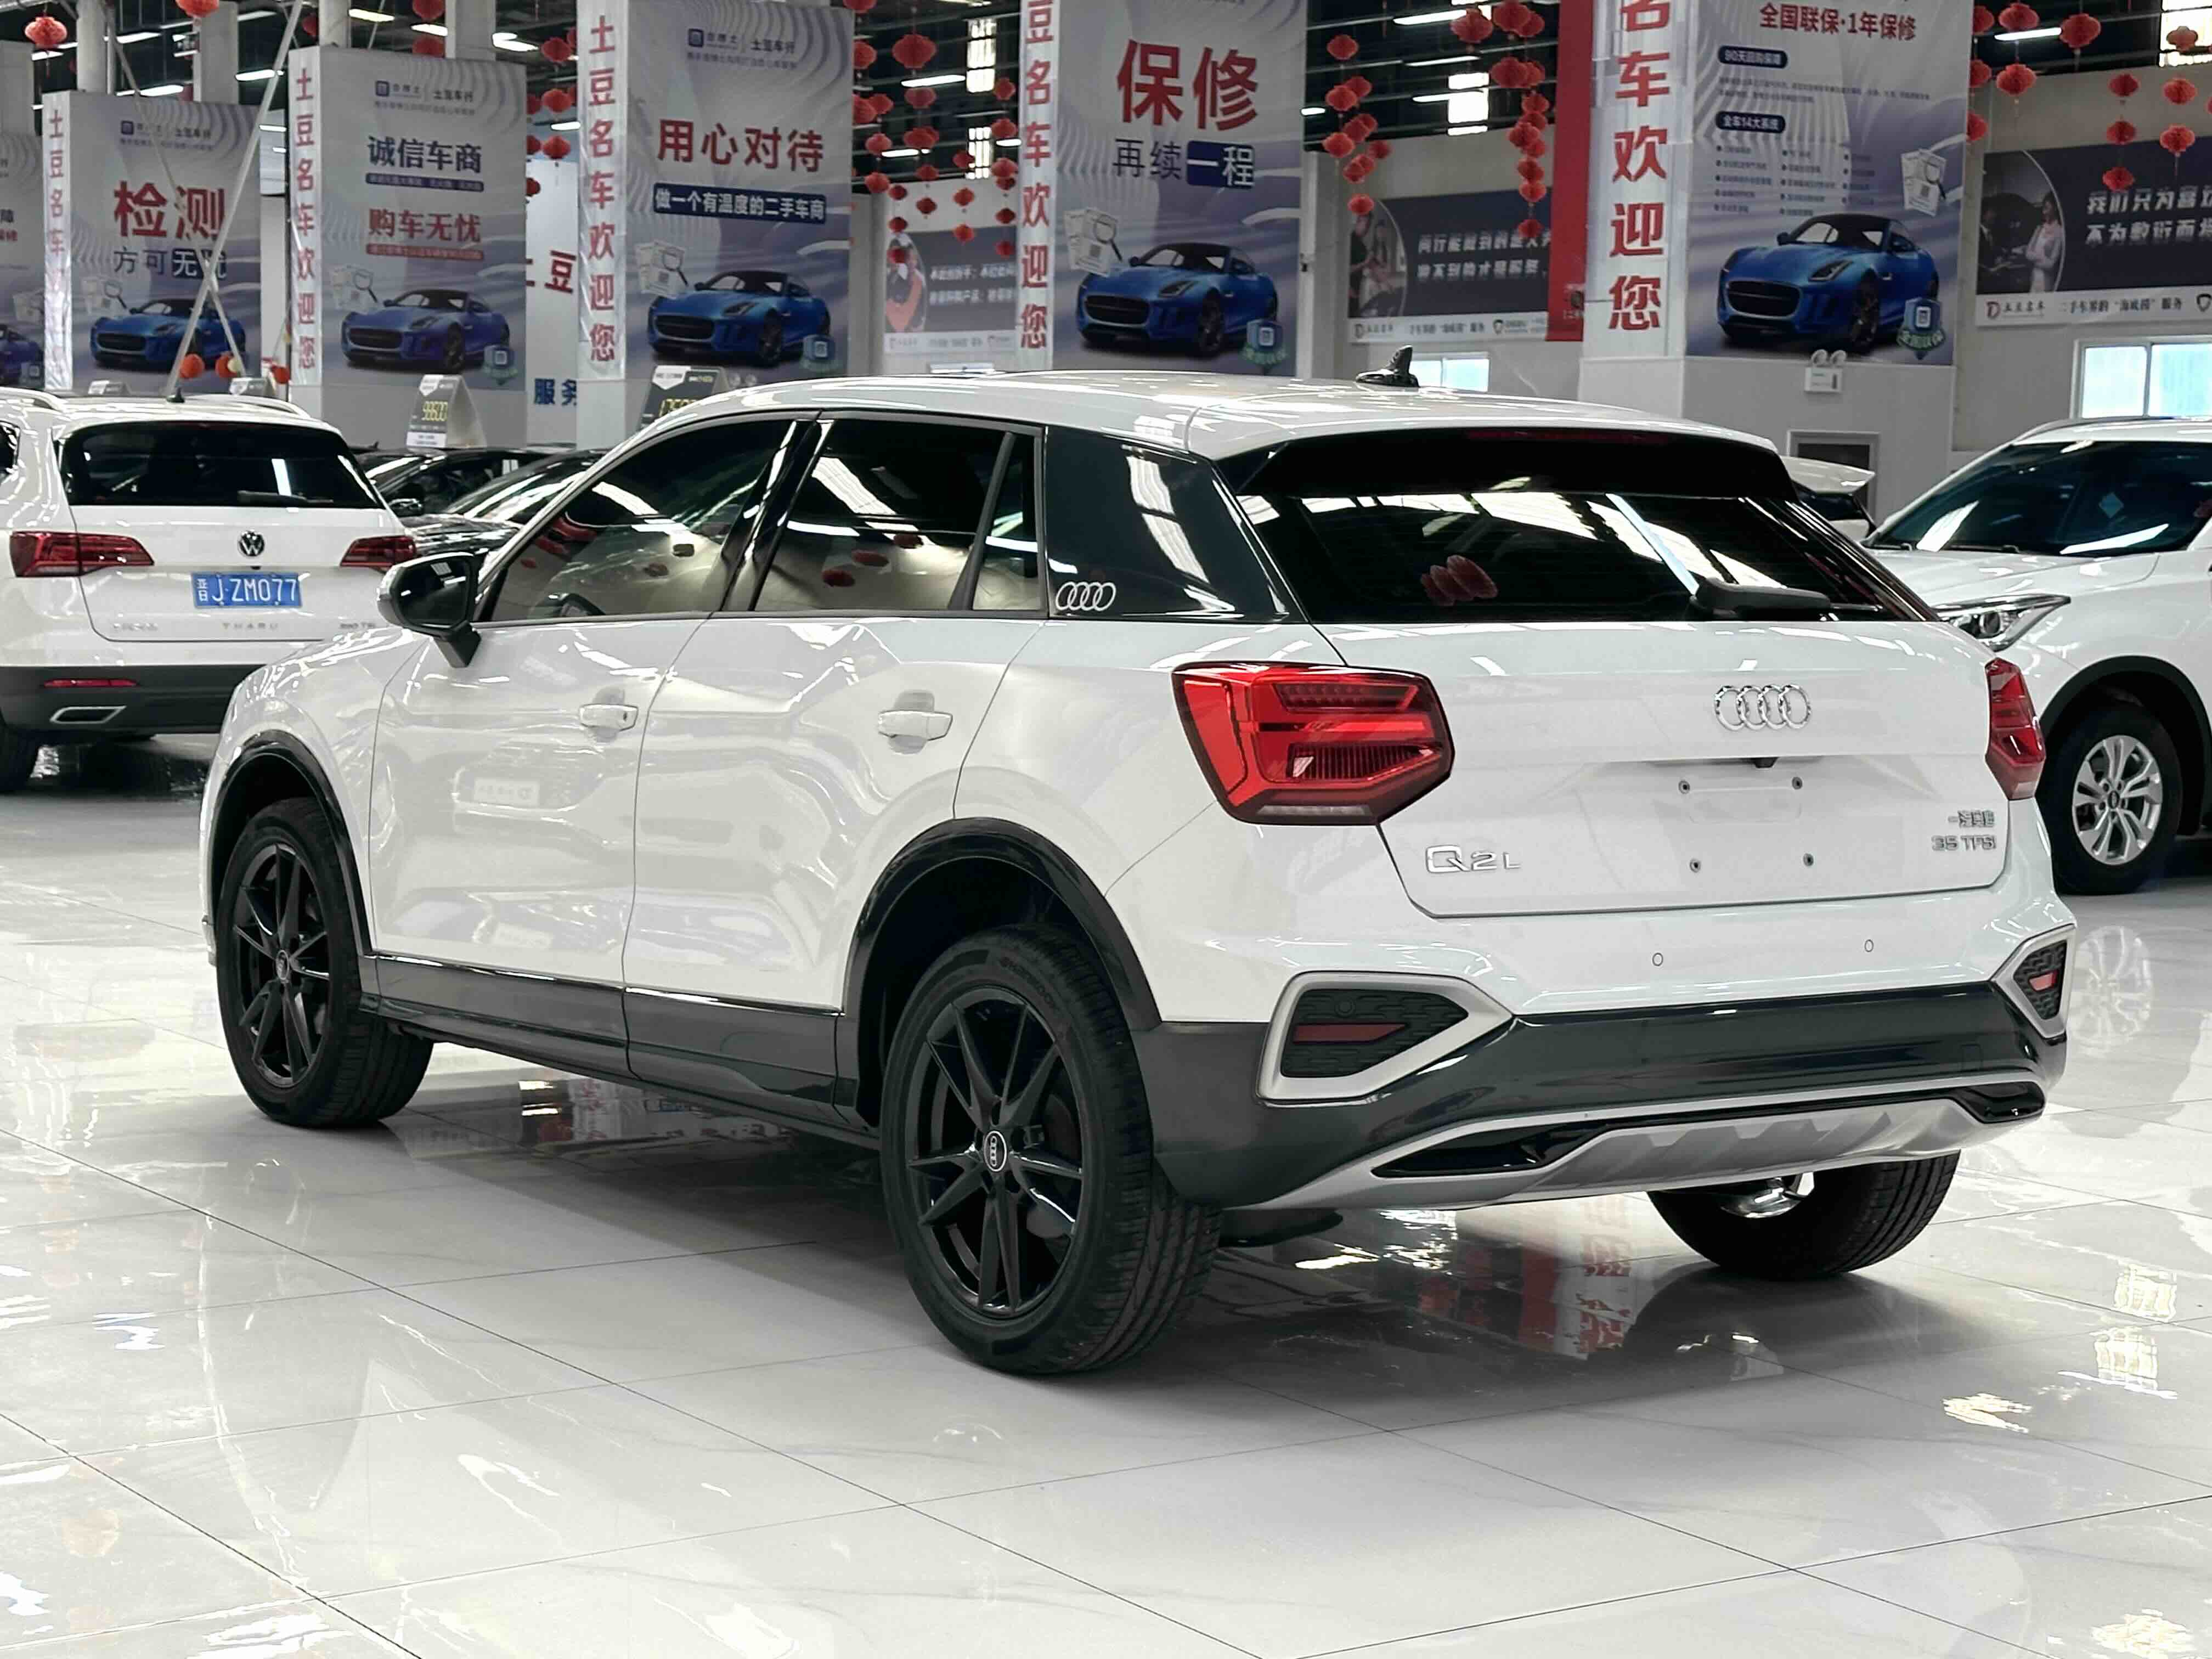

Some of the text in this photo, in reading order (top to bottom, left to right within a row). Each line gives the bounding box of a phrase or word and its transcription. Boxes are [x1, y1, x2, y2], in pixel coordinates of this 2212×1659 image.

[1759, 3, 1916, 41] 全国联保·1年保修
[1117, 40, 1258, 131] 保修
[367, 135, 481, 173] 诚信车商
[658, 119, 824, 172] 用心对待
[1113, 138, 1255, 189] 再续一程
[589, 15, 616, 362] 土豆名车欢迎您
[1020, 0, 1054, 349] 豆名车欢迎您
[114, 181, 224, 240] 检测
[296, 68, 315, 369] 土豆名车欢迎您
[369, 208, 481, 242] 购车无忧
[656, 188, 823, 219] 做一个有温度的二手车商
[534, 379, 577, 405] 服务
[1426, 844, 1522, 874] Q2L
[1931, 833, 1997, 851] 35 TFSI
